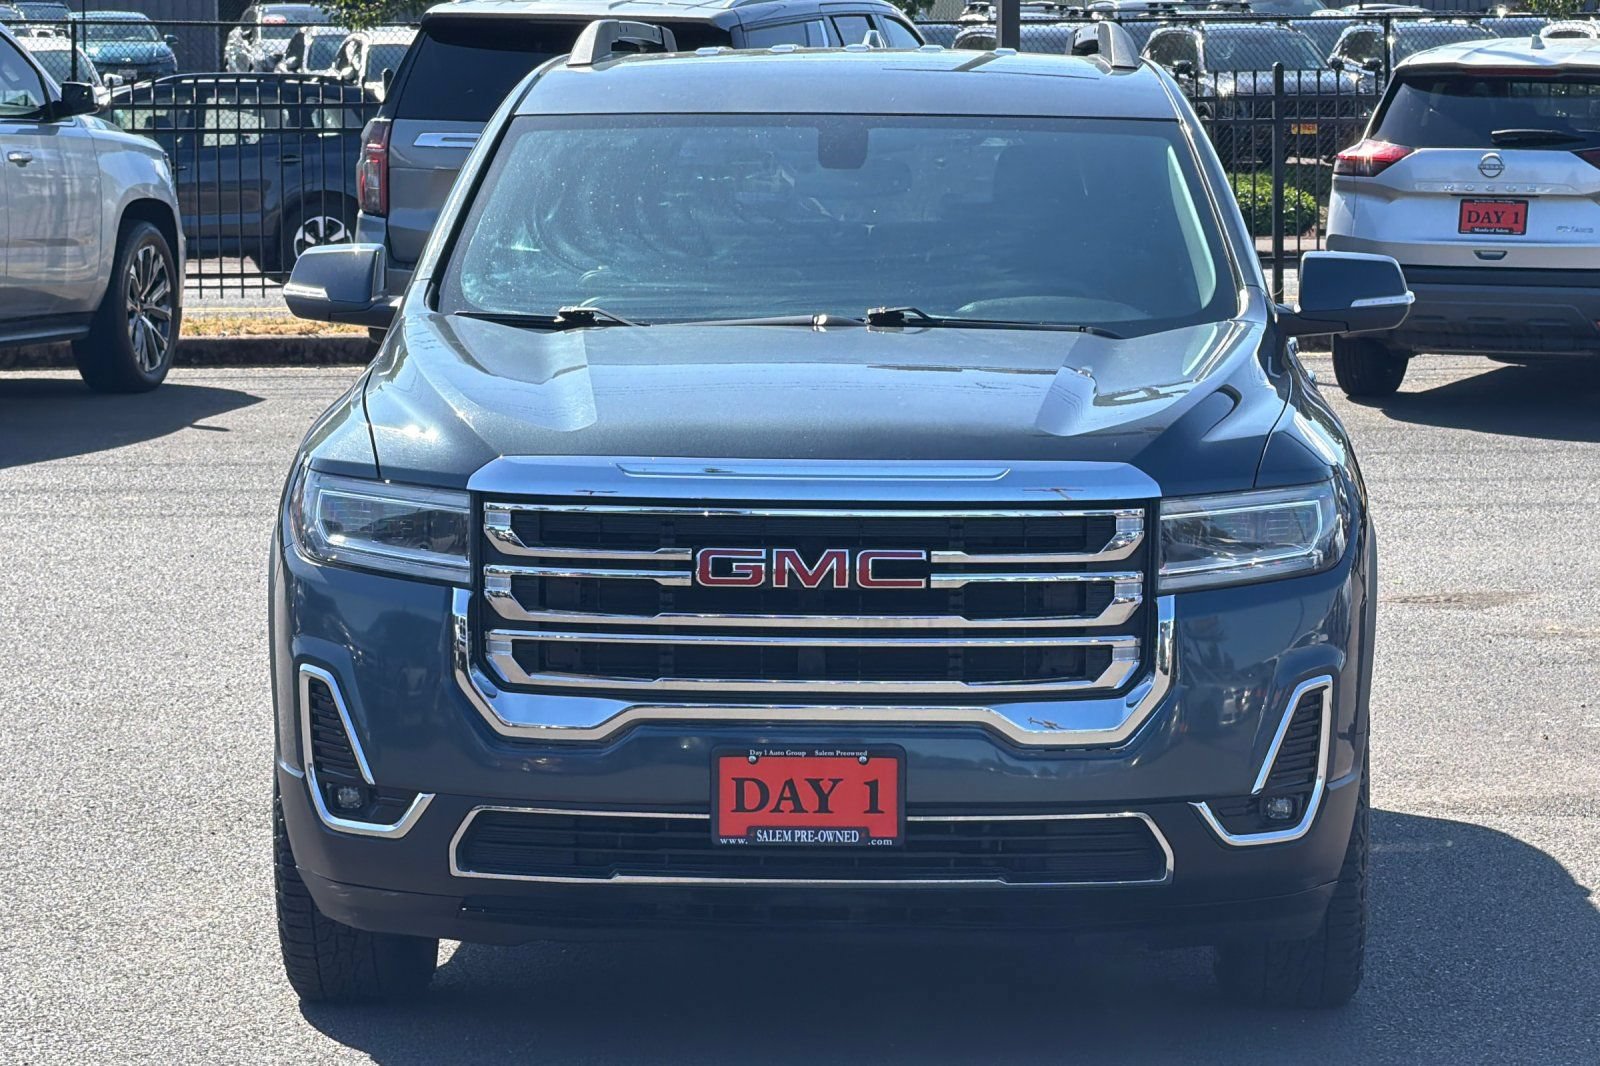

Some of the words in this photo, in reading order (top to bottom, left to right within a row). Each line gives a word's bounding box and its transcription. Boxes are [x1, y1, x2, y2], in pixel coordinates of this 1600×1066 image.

[1467, 210, 1505, 224] DAY
[1513, 211, 1519, 224] 1
[696, 548, 926, 589] GMC
[749, 749, 762, 757] Day
[785, 749, 807, 758] Group
[731, 777, 844, 814] DAY
[863, 779, 885, 814] 1
[719, 837, 748, 845] www.
[756, 829, 793, 842] SALEM
[794, 830, 860, 843] PRE-OWNED
[867, 837, 893, 846] .com
